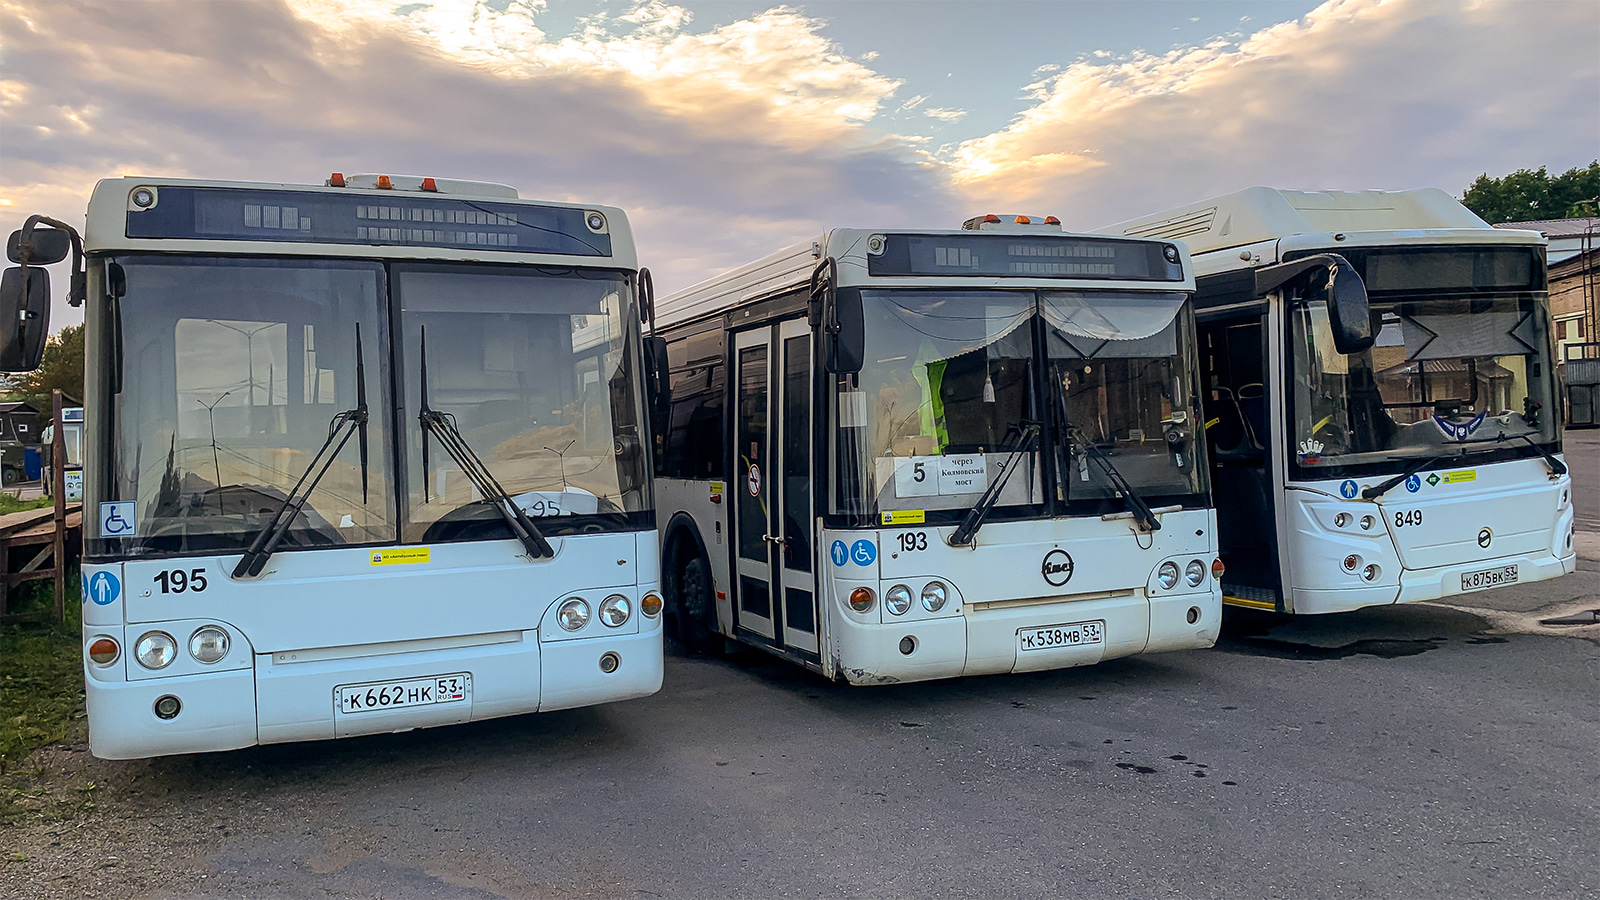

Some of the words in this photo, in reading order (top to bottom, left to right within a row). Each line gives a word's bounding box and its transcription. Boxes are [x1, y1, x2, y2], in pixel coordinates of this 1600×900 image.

[913, 462, 926, 483] 5
[941, 467, 985, 477] Колмовский
[951, 458, 973, 467] через
[1394, 509, 1423, 528] 849
[896, 531, 928, 552] 193
[153, 568, 208, 594] 195
[1505, 566, 1515, 577] 53
[1026, 629, 1080, 648] К538МВ
[1083, 624, 1096, 637] 53
[350, 686, 432, 709] К662НК
[438, 679, 458, 694] 53
